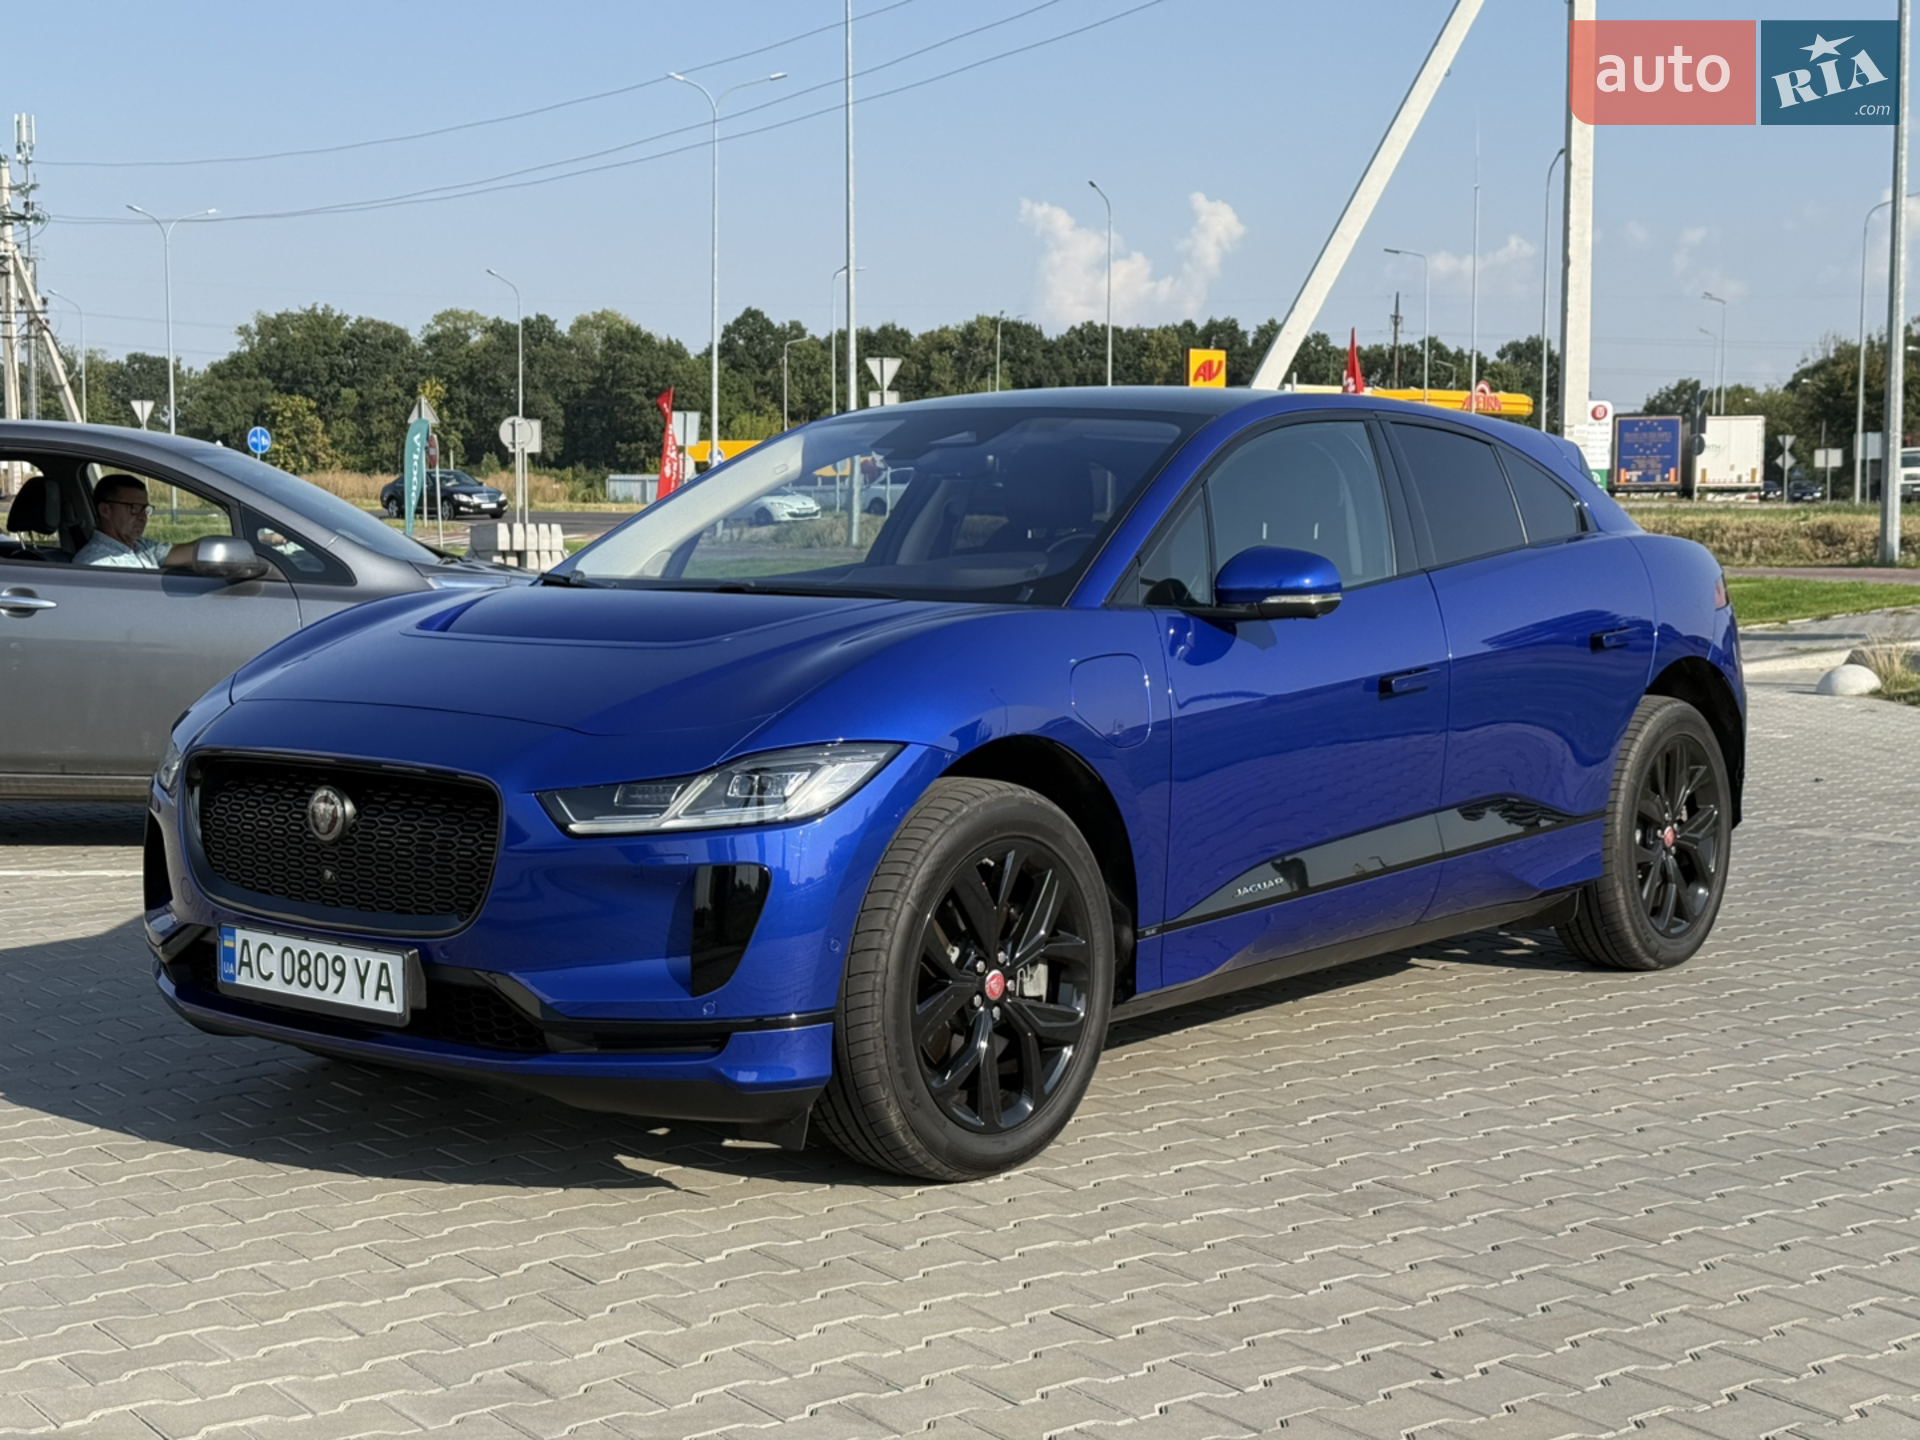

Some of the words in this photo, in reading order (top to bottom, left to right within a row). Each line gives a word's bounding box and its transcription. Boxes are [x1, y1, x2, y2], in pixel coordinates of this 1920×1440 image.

[1232, 876, 1284, 898] JAGUAR
[223, 961, 235, 975] UA
[237, 938, 275, 982] AC
[281, 945, 347, 995] 0809
[354, 957, 395, 1004] YA
